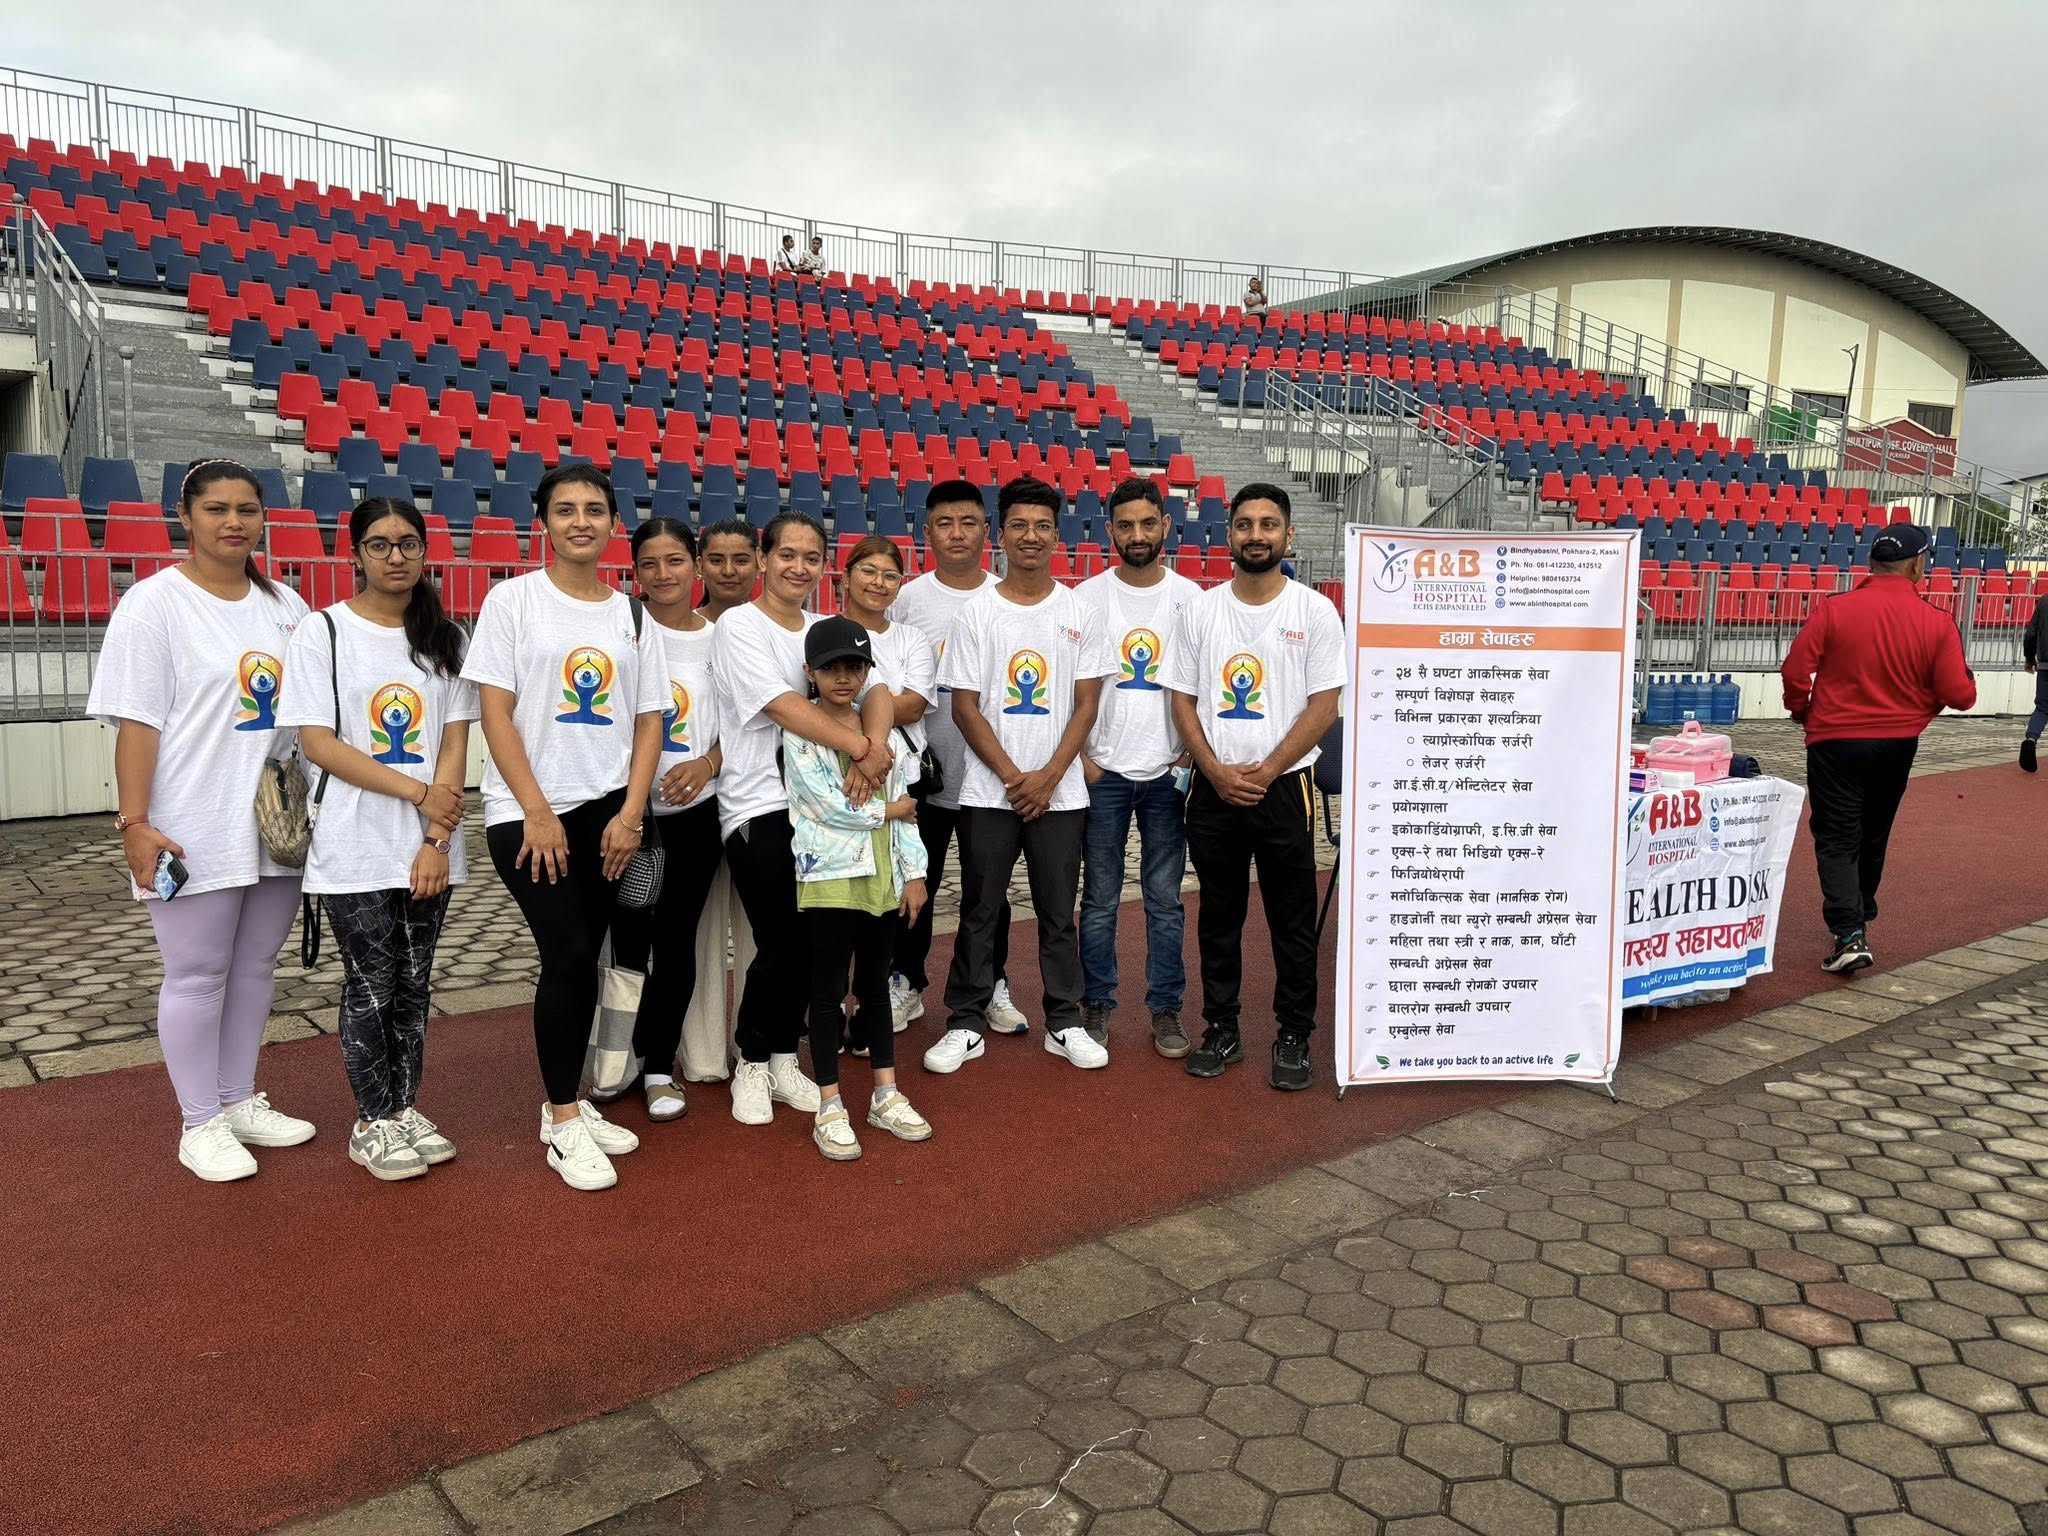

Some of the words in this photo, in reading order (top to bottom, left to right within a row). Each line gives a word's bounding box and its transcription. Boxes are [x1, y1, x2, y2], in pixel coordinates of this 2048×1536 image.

[1511, 547, 1560, 555] Bindhyabasini,
[1562, 548, 1598, 556] Pokhara-2,
[1414, 549, 1480, 579] A&B
[1413, 583, 1487, 593] INTERNATIONAL
[1414, 592, 1486, 603] HOSPITAL
[1413, 602, 1433, 611] ECHS
[1434, 602, 1486, 611] EMPANELLED
[1396, 667, 1411, 680] २४
[1433, 668, 1462, 678] घण्टा
[1467, 665, 1523, 679] आकस्मिक
[1528, 667, 1549, 680] सेवा
[1395, 687, 1429, 703] सम्पूर्ण
[1395, 709, 1432, 722] विभिन्न
[1438, 713, 1482, 725] प्रकारका
[1488, 711, 1542, 725] शल्यक्रिया
[1423, 732, 1496, 747] ल्याप्रोस्कोपिक
[1502, 734, 1533, 749] सर्जरी
[1422, 755, 1449, 770] लेजर
[1455, 755, 1485, 770] सर्जरी
[1513, 779, 1533, 792] सेवा
[1392, 799, 1448, 814] प्रयोगशाला
[1649, 790, 1702, 836] A&B
[1538, 824, 1557, 837] सेवा
[1392, 845, 1431, 859] एक्स-रे
[1436, 847, 1457, 857] तथा
[1463, 845, 1502, 860] भिडियो
[1508, 846, 1545, 860] एक्स-रे
[1391, 867, 1465, 882] फिजियोथेरापी
[1391, 888, 1463, 903] मनोचिकित्सक
[1469, 890, 1490, 903] सेवा
[1496, 889, 1540, 904] (मानसिक
[1545, 889, 1567, 904] रोग)
[1624, 877, 1718, 925] EALTH
[1726, 868, 1770, 909] DSK
[1441, 915, 1461, 925] तथा
[1497, 912, 1532, 925] सम्बन्धी
[1537, 912, 1570, 925] अप्रेसन
[1576, 912, 1596, 925] सेवा
[1390, 933, 1423, 948] महिला
[1428, 936, 1449, 947] तथा
[1455, 934, 1474, 948] स्त्री
[1480, 937, 1489, 948] र
[1491, 936, 1514, 948] नाक,
[1520, 936, 1544, 947] कान,
[1390, 956, 1429, 970] सम्बन्धी
[1435, 957, 1468, 970] अप्रेसन
[1473, 956, 1493, 970] सेवा
[1388, 981, 1417, 992] छाला
[1423, 978, 1461, 992] सम्बन्धी
[1466, 978, 1498, 992] रोगको
[1502, 979, 1539, 991] उपचार
[1435, 999, 1471, 1015] सम्बन्धी
[1476, 1001, 1512, 1013] उपचार
[1436, 1023, 1455, 1036] सेवा
[1400, 1058, 1411, 1067] We
[1414, 1057, 1434, 1066] take
[1437, 1056, 1453, 1069] you
[1456, 1056, 1477, 1065] back
[1480, 1056, 1489, 1065] to
[1492, 1056, 1503, 1064] an
[1505, 1055, 1534, 1065] active
[1537, 1055, 1553, 1065] life
